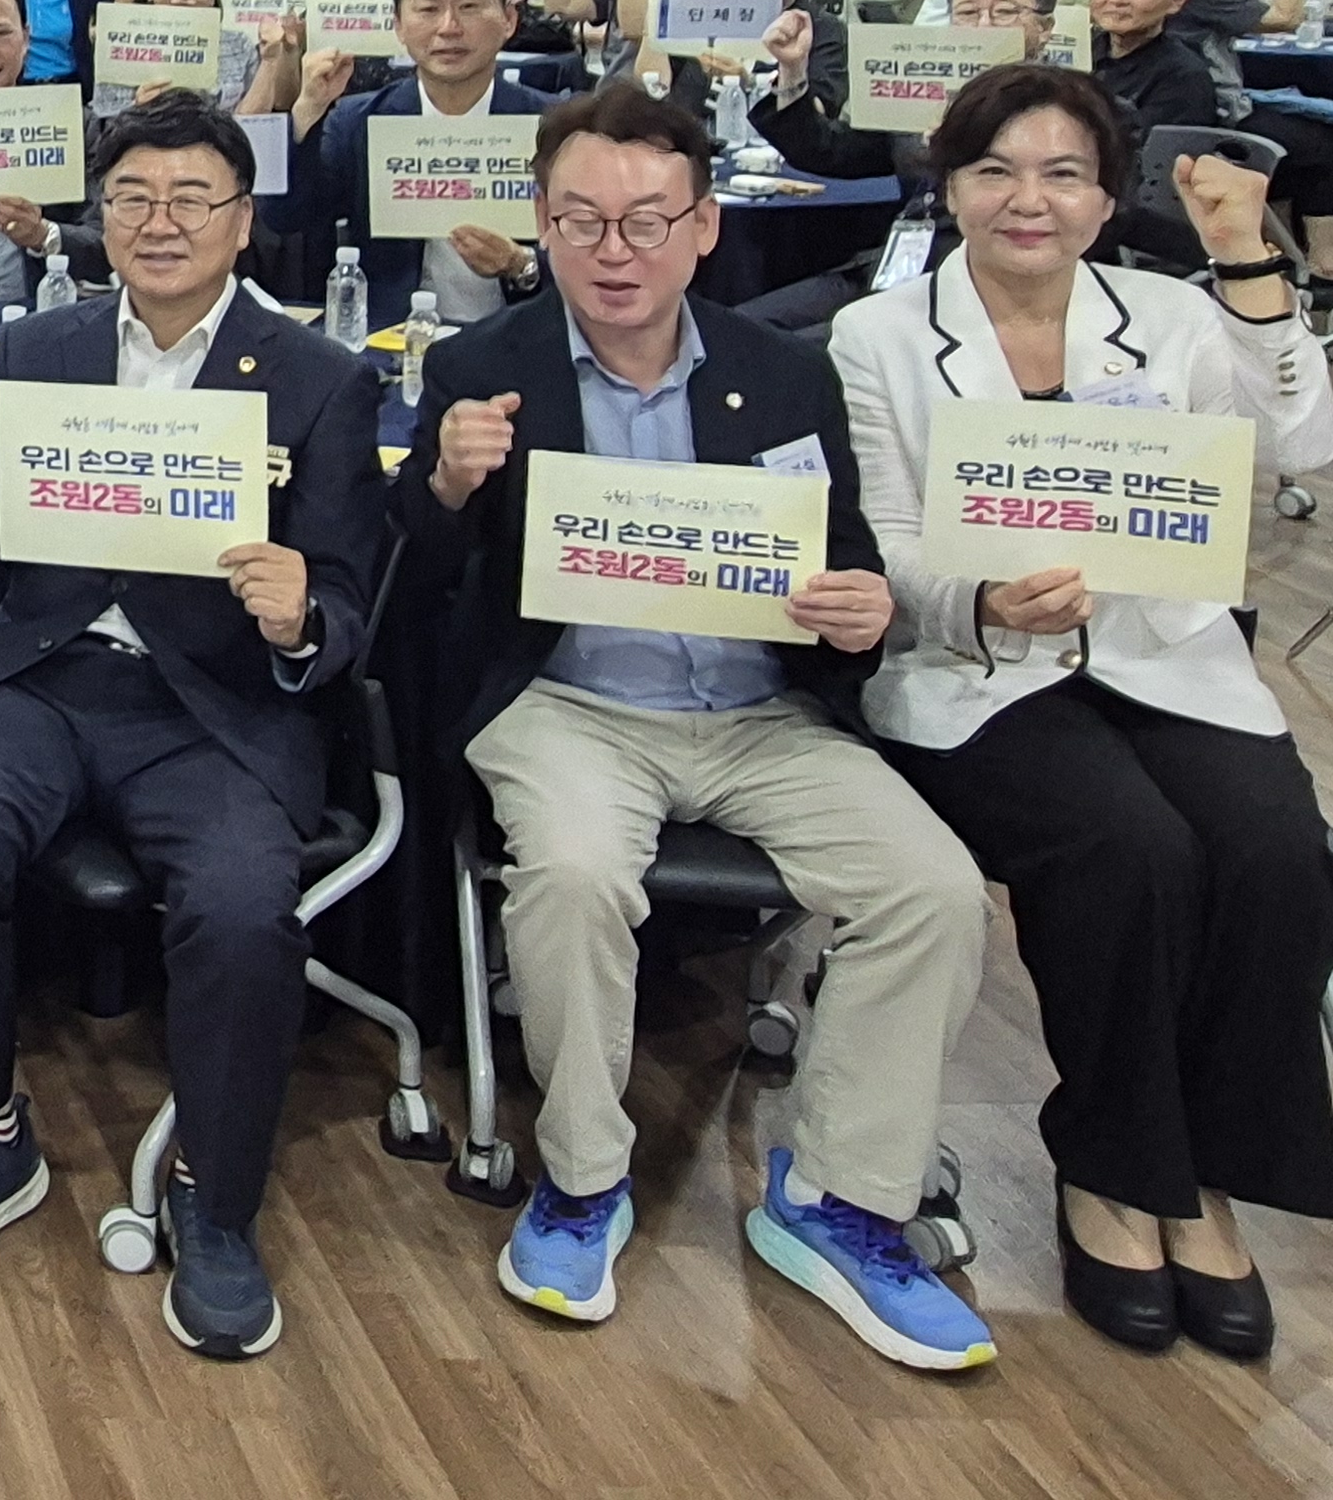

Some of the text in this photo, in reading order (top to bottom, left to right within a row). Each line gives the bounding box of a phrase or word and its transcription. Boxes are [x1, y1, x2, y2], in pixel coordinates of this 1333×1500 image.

[865, 59, 953, 77] 우리 손으로
[20, 125, 68, 143] 만드는
[25, 146, 65, 167] 미래
[386, 157, 422, 174] 우리
[427, 157, 481, 175] 손으로
[21, 445, 70, 472] 우리
[78, 449, 155, 476] 손으로
[163, 453, 243, 482] 만드는
[29, 478, 235, 521] 조원2동의 미래
[954, 462, 1221, 507] 우리 손으로 만드는
[552, 514, 800, 561] 우리 손으로 만드는
[961, 495, 1209, 545] 조원2동의 미래
[558, 546, 793, 601] 조원2동의 미래
